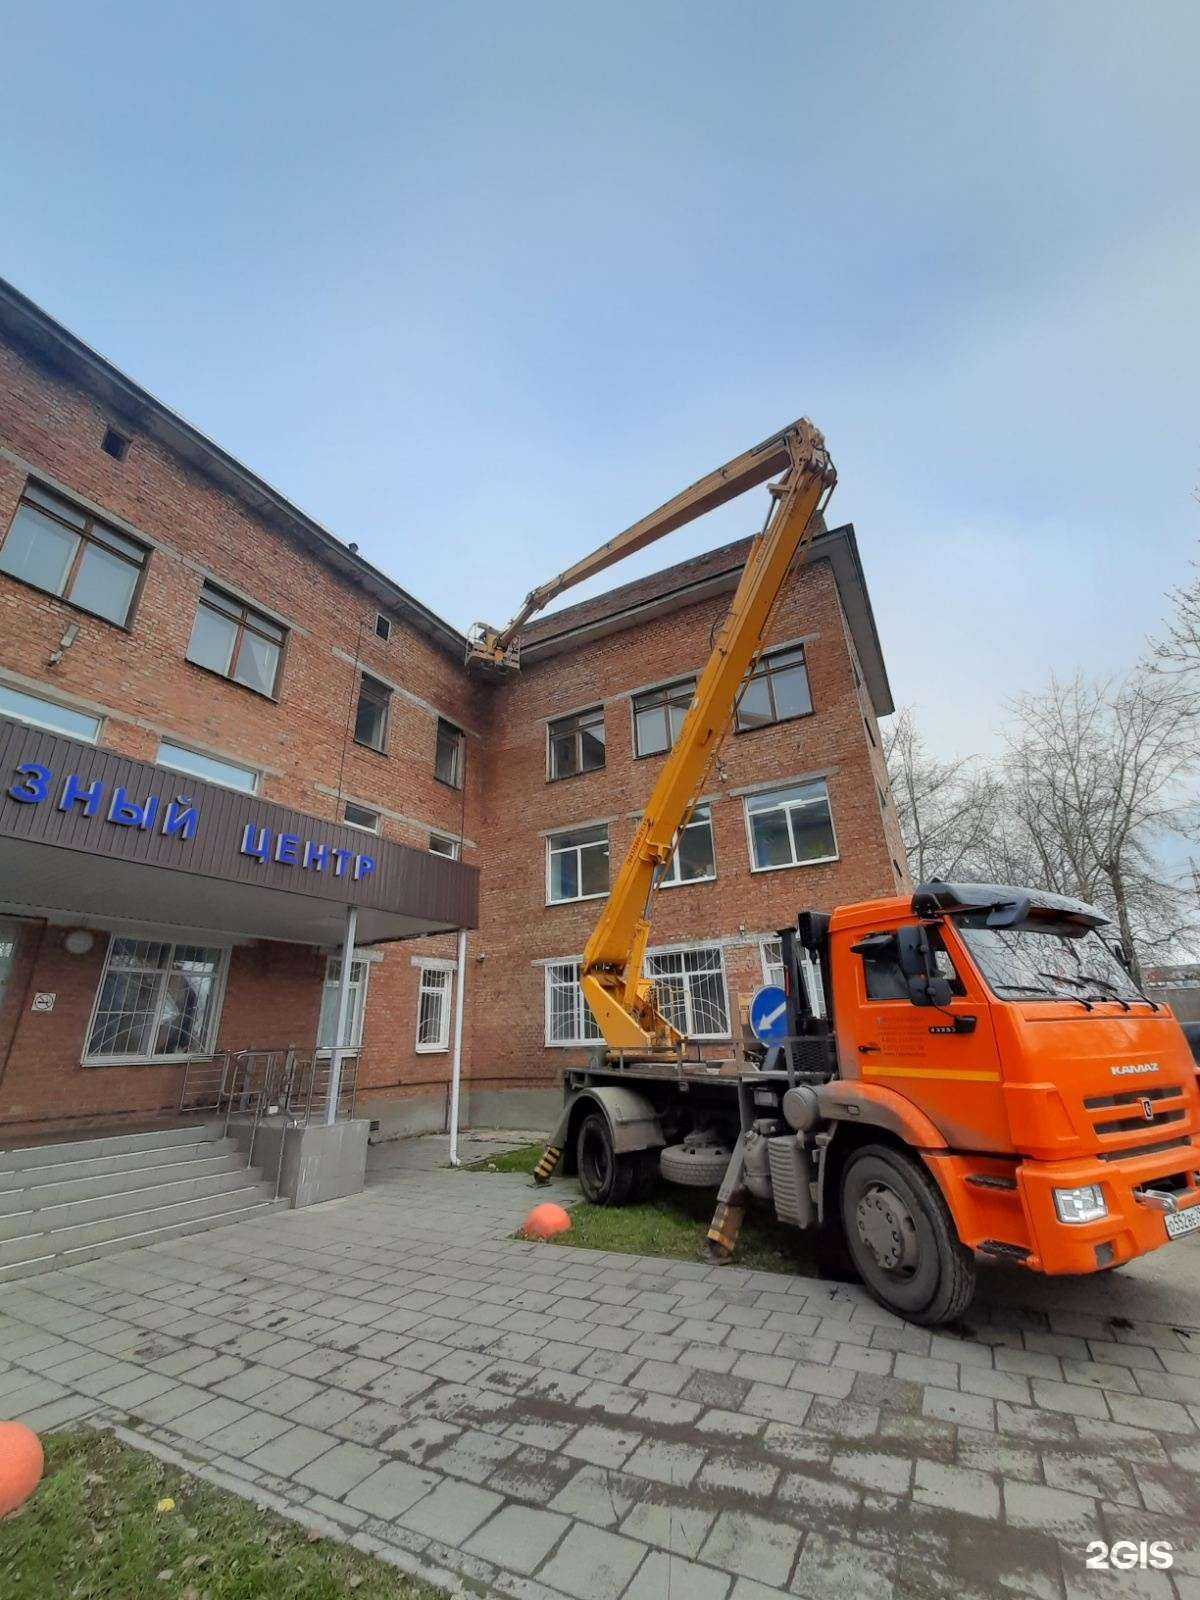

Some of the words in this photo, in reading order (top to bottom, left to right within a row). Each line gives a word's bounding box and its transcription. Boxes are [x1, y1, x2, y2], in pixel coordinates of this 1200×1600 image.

[7, 762, 200, 840] ЗНЫЙ
[240, 822, 377, 881] ЦЕНТР
[1110, 1062, 1160, 1076] KAMAZ
